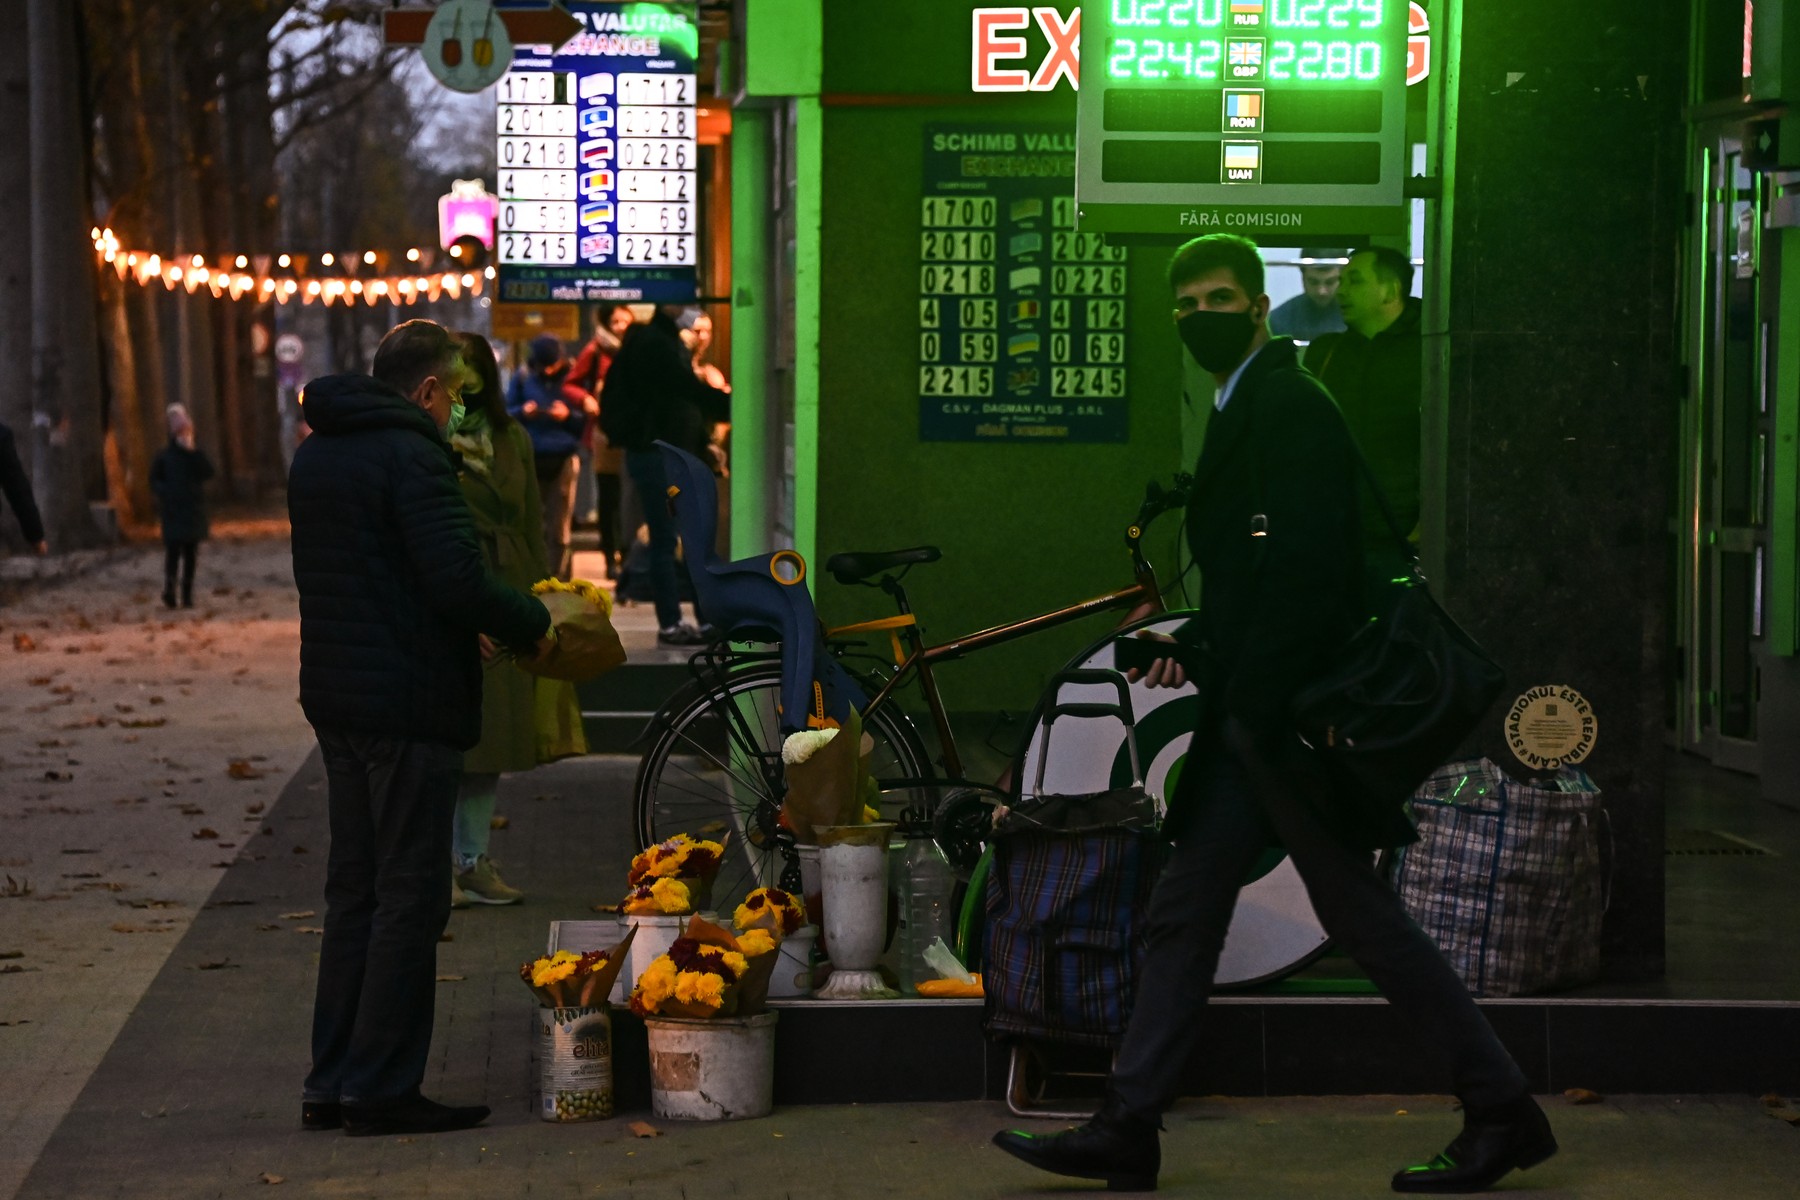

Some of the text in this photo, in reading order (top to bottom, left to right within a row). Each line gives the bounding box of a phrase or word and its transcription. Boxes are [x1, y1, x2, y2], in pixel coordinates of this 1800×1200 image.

[1233, 14, 1260, 26] RUB
[1108, 39, 1223, 79] 22.42
[1232, 66, 1259, 77] GBP
[1267, 40, 1382, 80] 22.80
[624, 79, 687, 102] 1712
[504, 107, 565, 132] 2010
[625, 110, 687, 134] 2028
[1230, 117, 1256, 128] RON
[504, 141, 566, 164] 0218
[933, 133, 1075, 151] SCHIMB VALU
[624, 143, 687, 168] 0226
[1228, 169, 1253, 179] UAH
[925, 200, 993, 227] 1700
[1179, 210, 1302, 226] FĂRĂ COMISION
[504, 236, 567, 261] 2215
[625, 238, 688, 262] 2245
[925, 233, 992, 260] 2010
[924, 268, 992, 294] 0218
[1055, 268, 1124, 294] 0226
[924, 301, 994, 328] 4 05
[1054, 303, 1122, 328] 4 12
[924, 335, 997, 360] 0 59
[1054, 336, 1122, 361] 0 69
[924, 368, 992, 393] 2215
[1055, 369, 1122, 395] 2245
[1559, 689, 1588, 715] ESTE
[1527, 716, 1593, 768] REPUBLICAN
